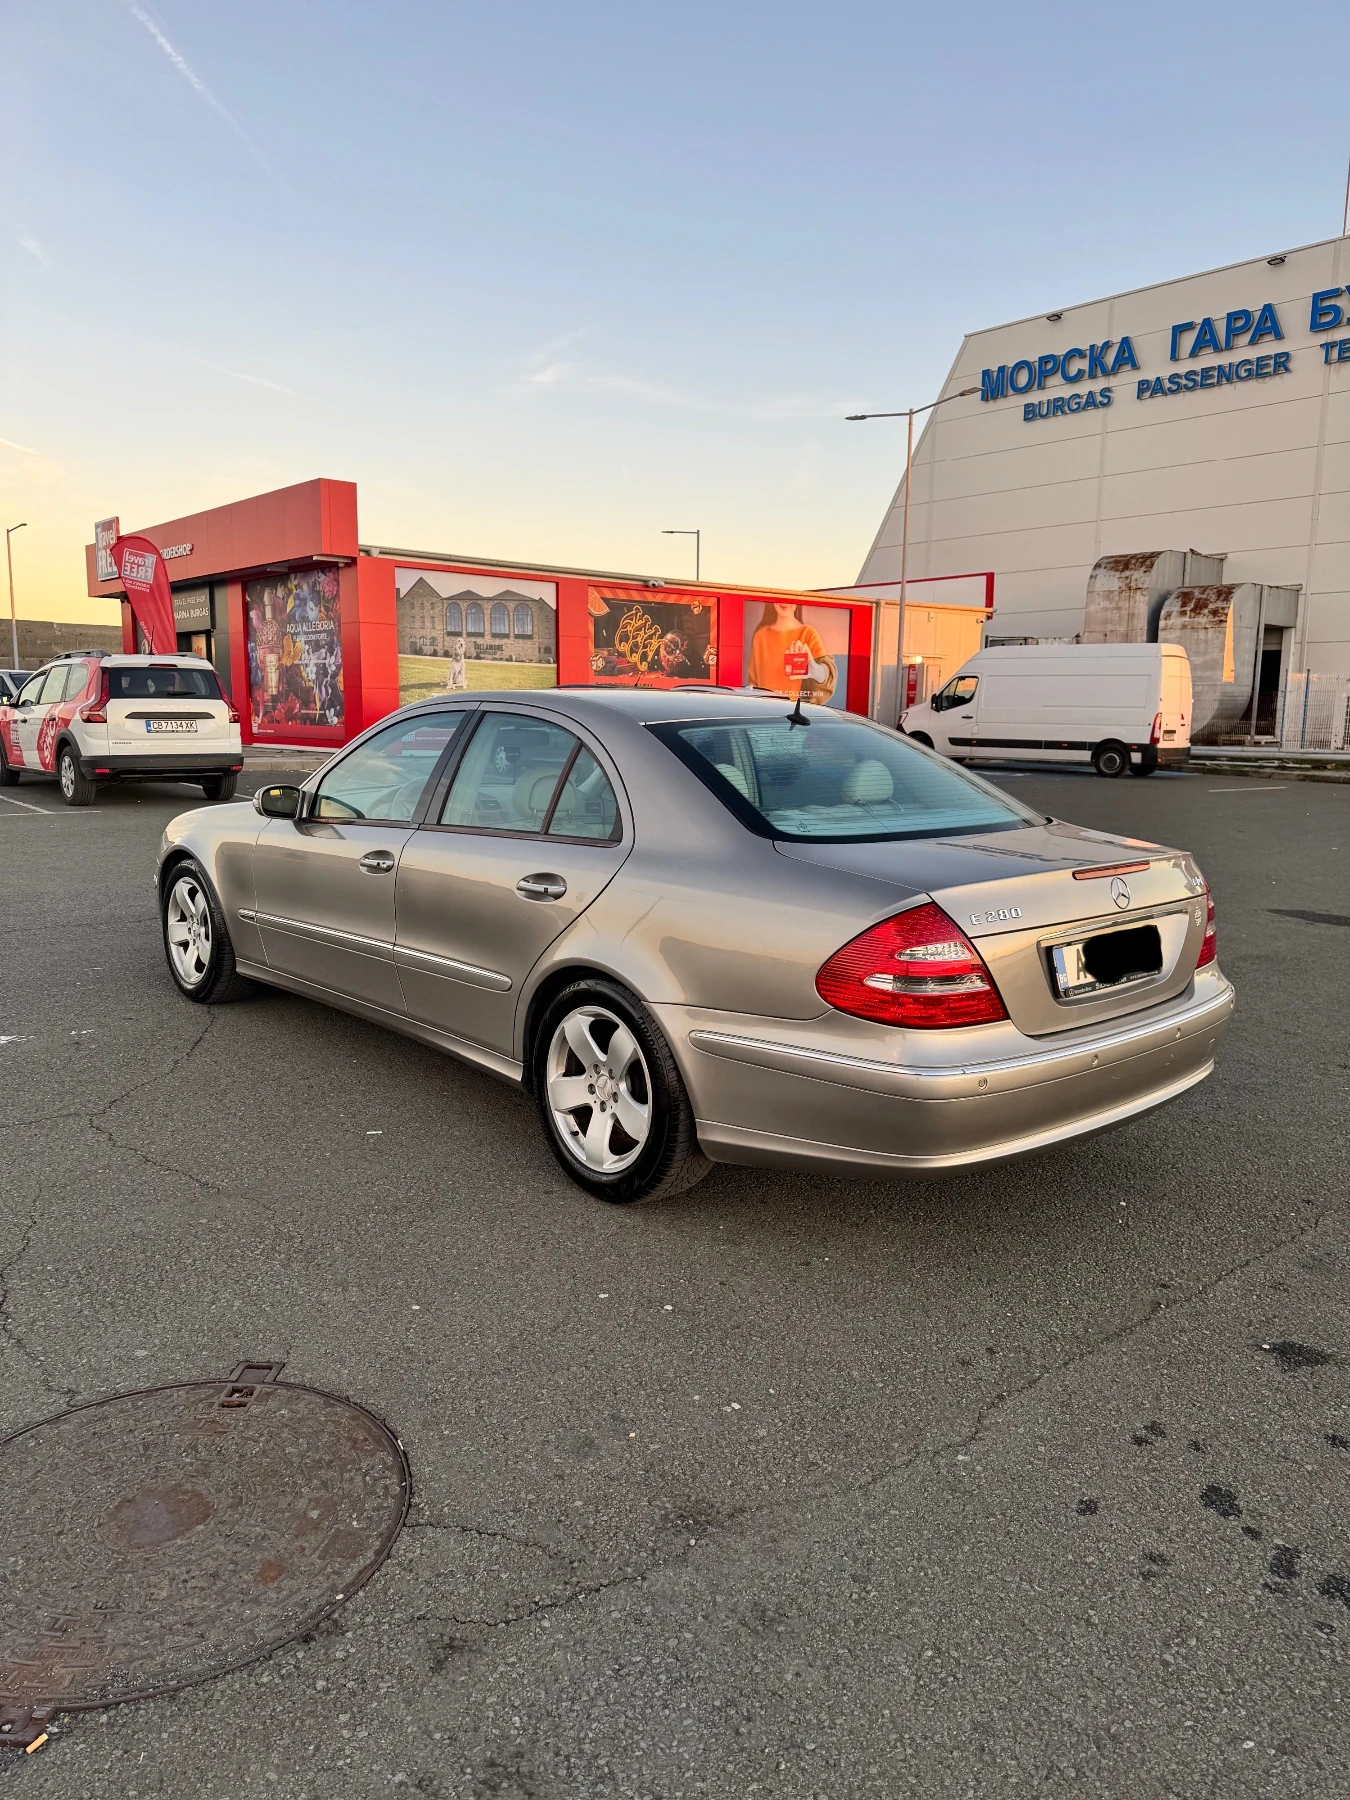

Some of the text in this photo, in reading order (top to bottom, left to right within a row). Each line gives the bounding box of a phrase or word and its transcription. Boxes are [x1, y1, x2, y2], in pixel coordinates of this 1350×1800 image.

[980, 336, 1140, 401] МОРСКА
[1169, 302, 1285, 361] ГАРА
[1023, 387, 1113, 422] BURGAS
[1136, 351, 1292, 400] PASSENGER
[96, 522, 116, 548] Travel
[190, 607, 209, 618] BURGAS
[286, 620, 334, 634] AQUA ALLEGORIA
[163, 721, 184, 730] 7134
[970, 907, 1022, 925] E 280
